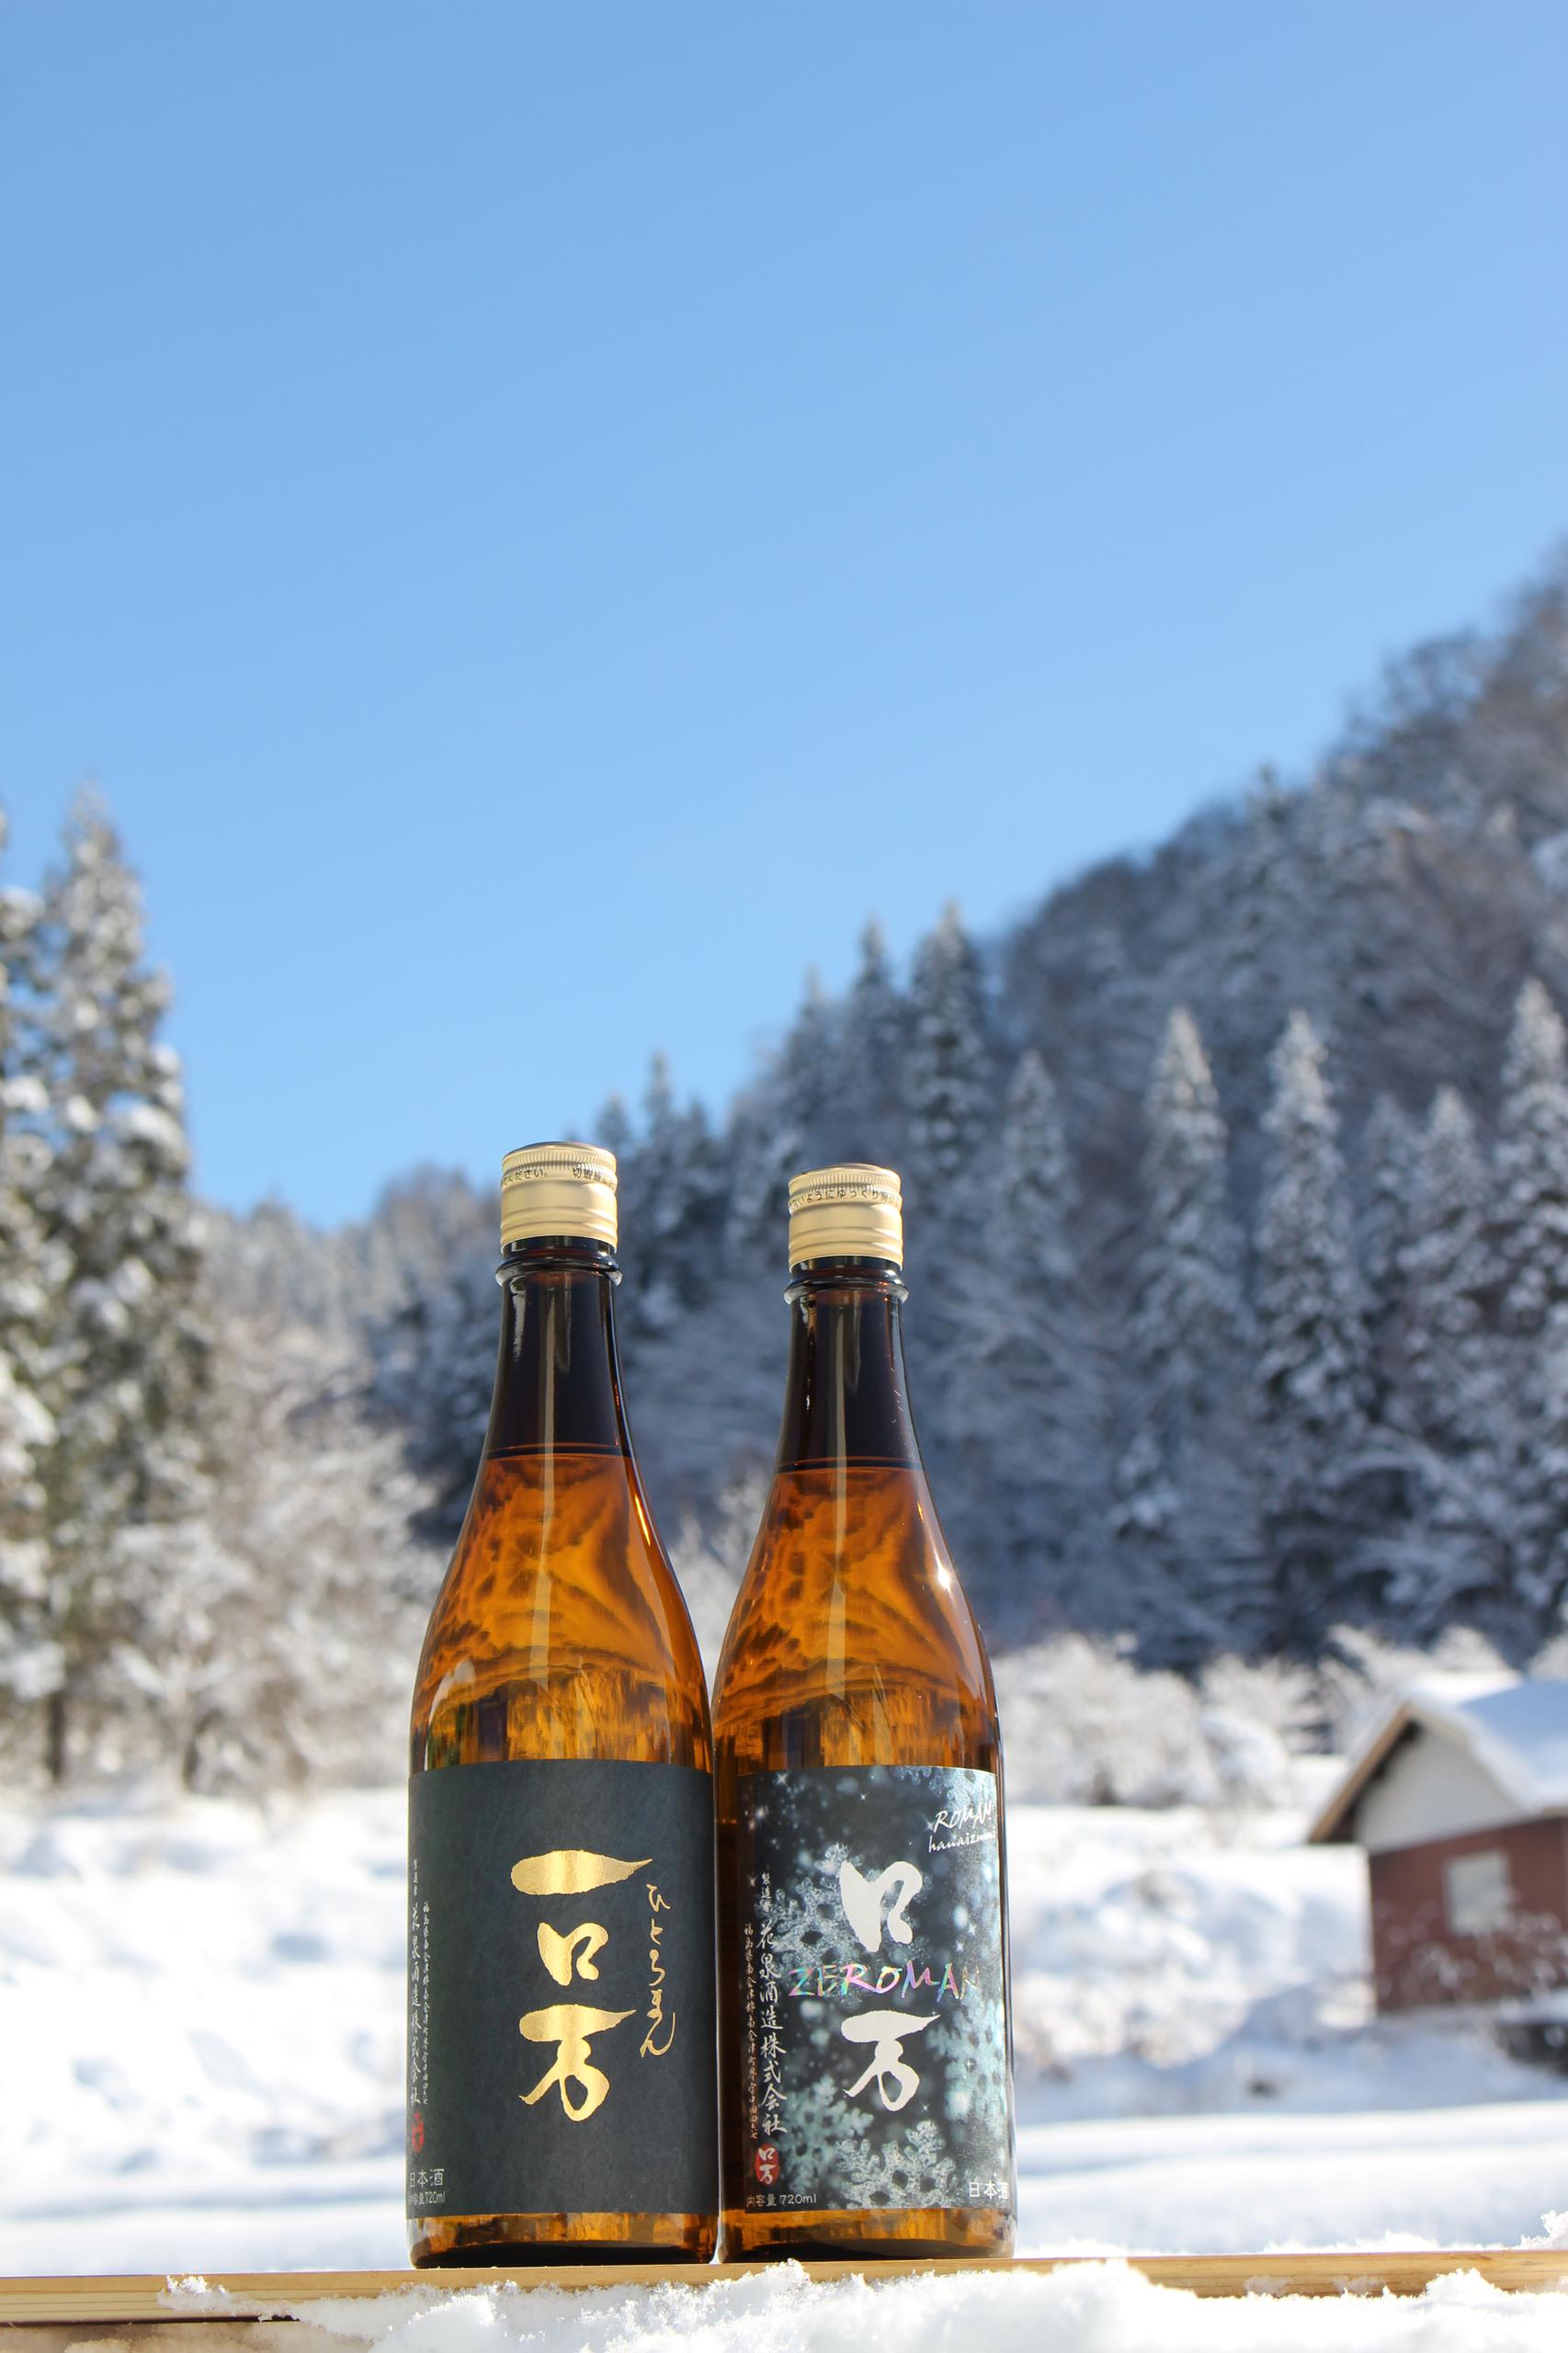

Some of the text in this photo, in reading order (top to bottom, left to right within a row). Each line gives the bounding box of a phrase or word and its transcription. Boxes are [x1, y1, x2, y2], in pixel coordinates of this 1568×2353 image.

[789, 1960, 980, 2003] ZEROMAN
[756, 1918, 788, 2135] 花泉酒造株式会社
[969, 2180, 1008, 2200] 日本酒
